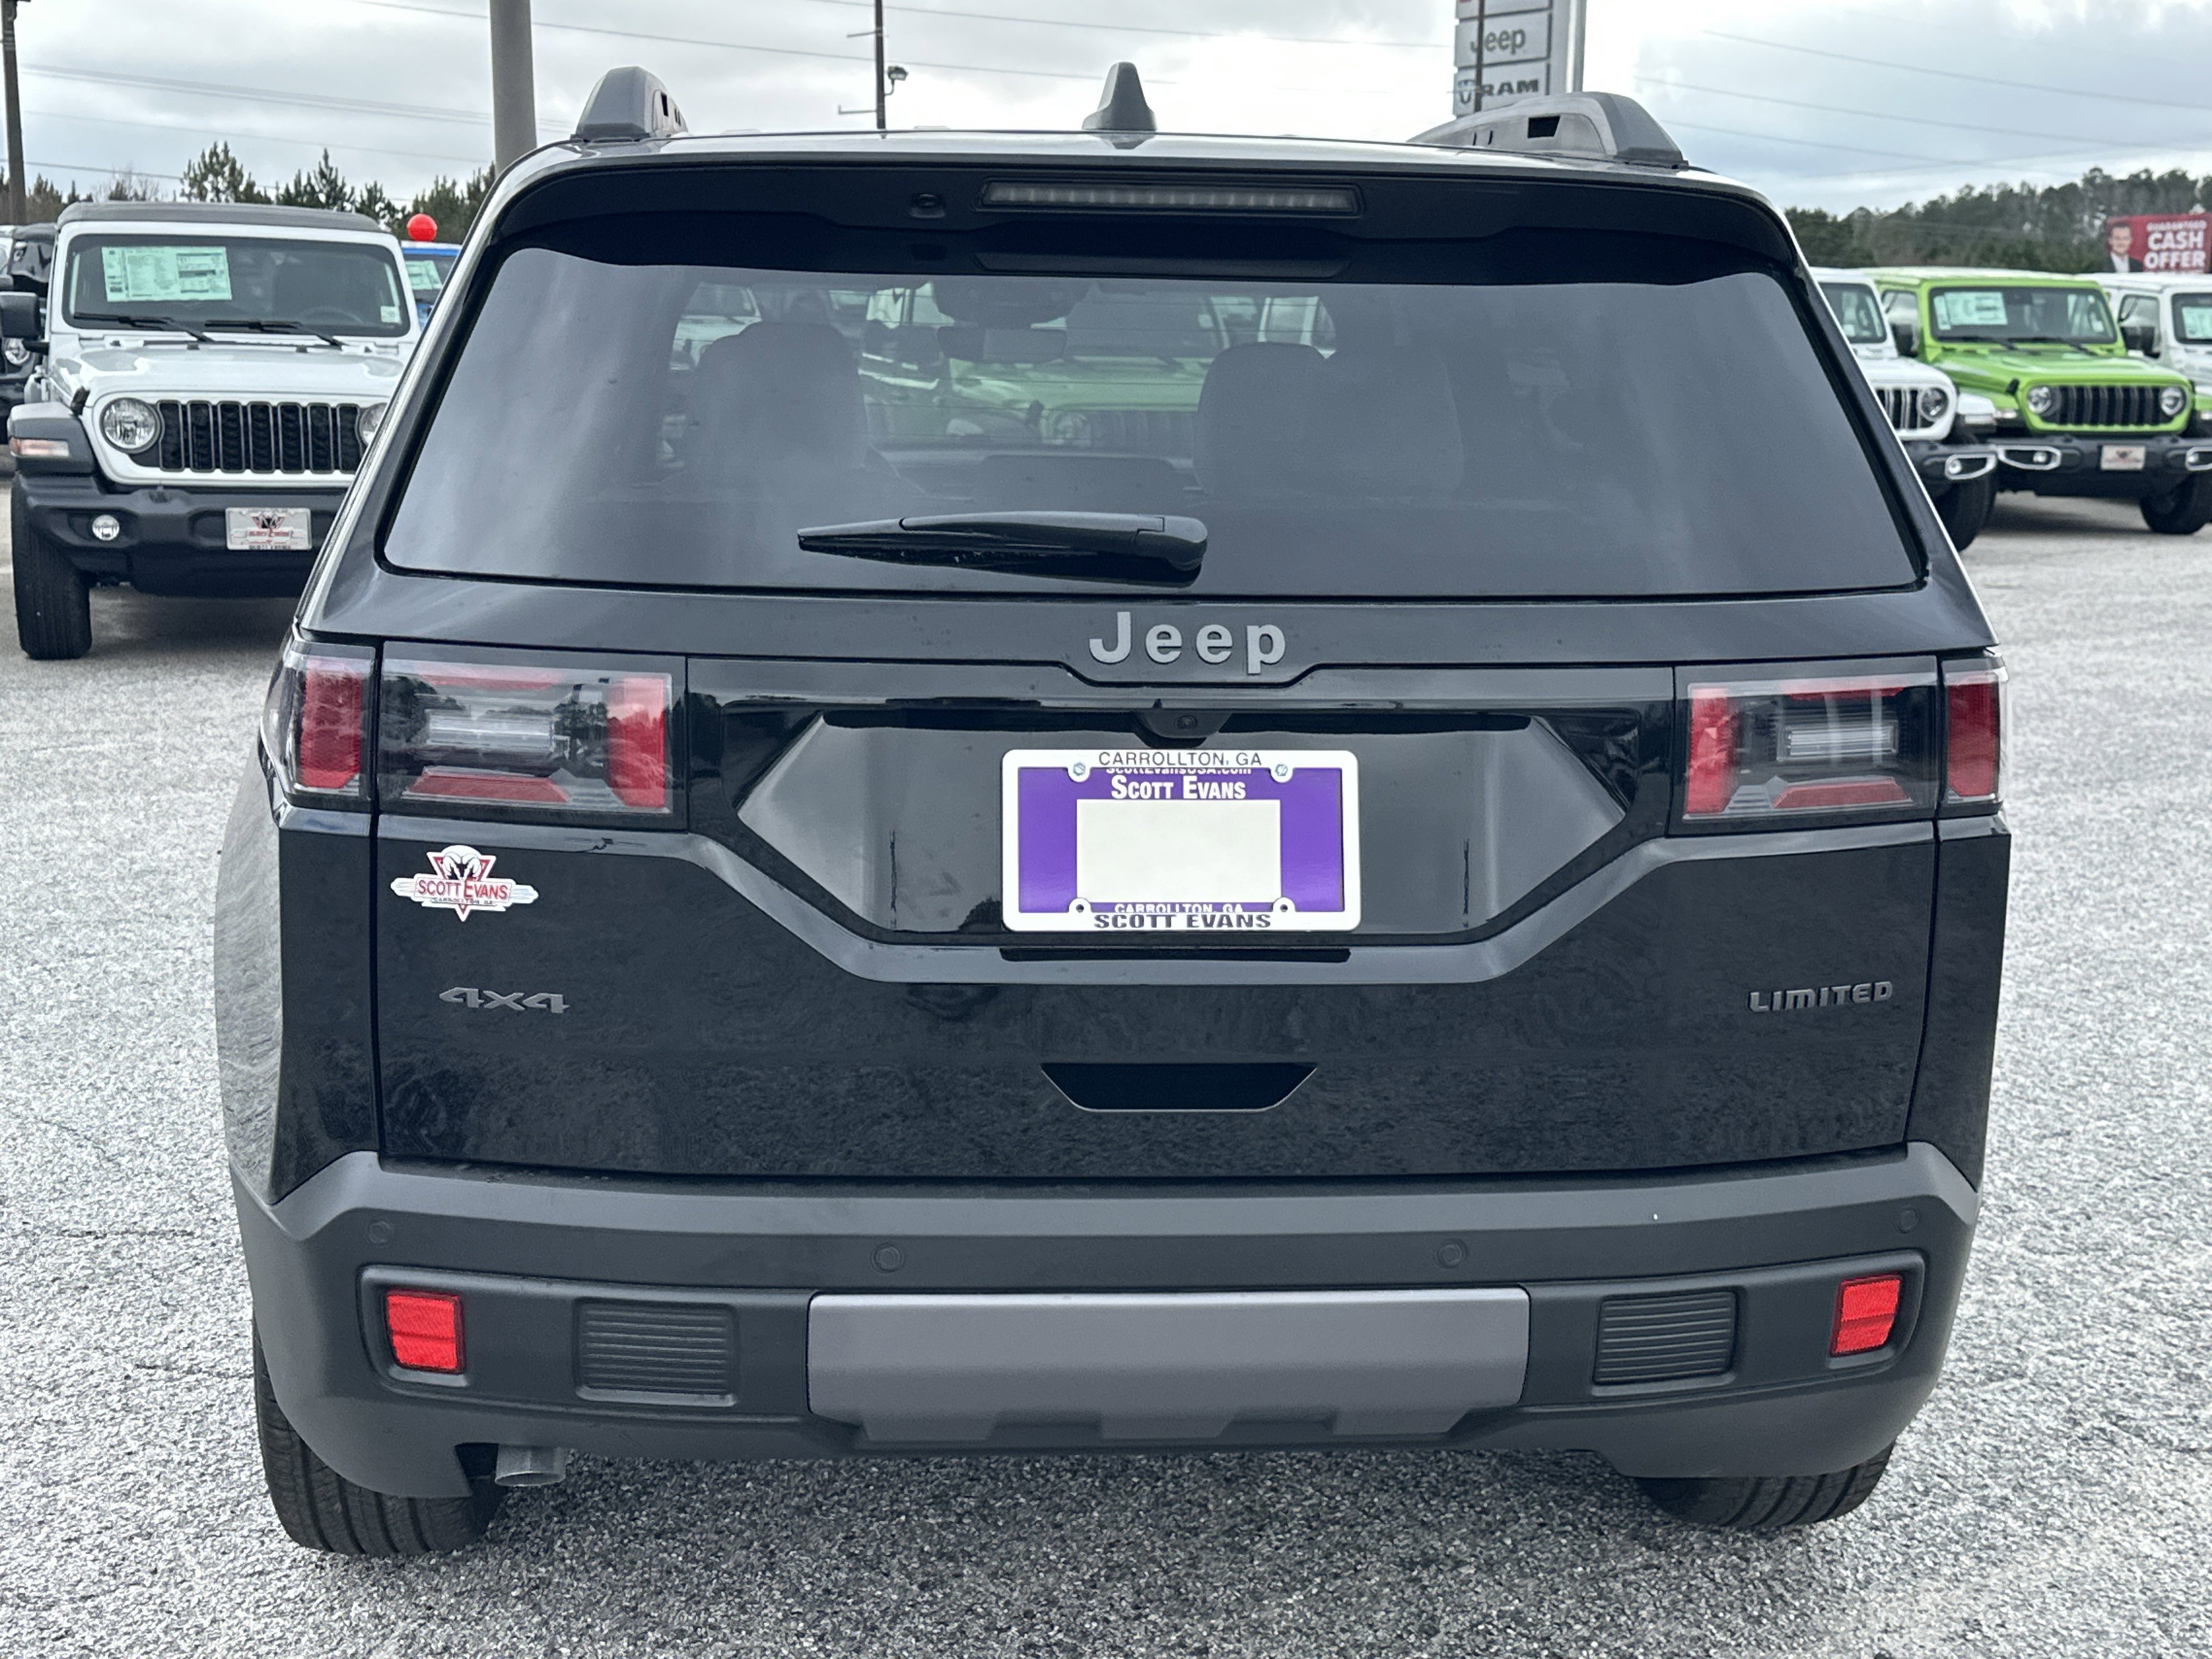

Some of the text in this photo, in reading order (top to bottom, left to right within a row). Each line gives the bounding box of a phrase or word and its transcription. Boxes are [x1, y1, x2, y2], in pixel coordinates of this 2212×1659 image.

[1480, 79, 1538, 96] RAM
[2147, 230, 2204, 251] CASH
[2143, 250, 2206, 268] OFFER
[1089, 611, 1286, 674] Jeep
[1099, 752, 1262, 766] CARROLLTON, GA
[1094, 914, 1271, 928] SCOTT EVANS
[1749, 981, 1893, 1012] LIMITED
